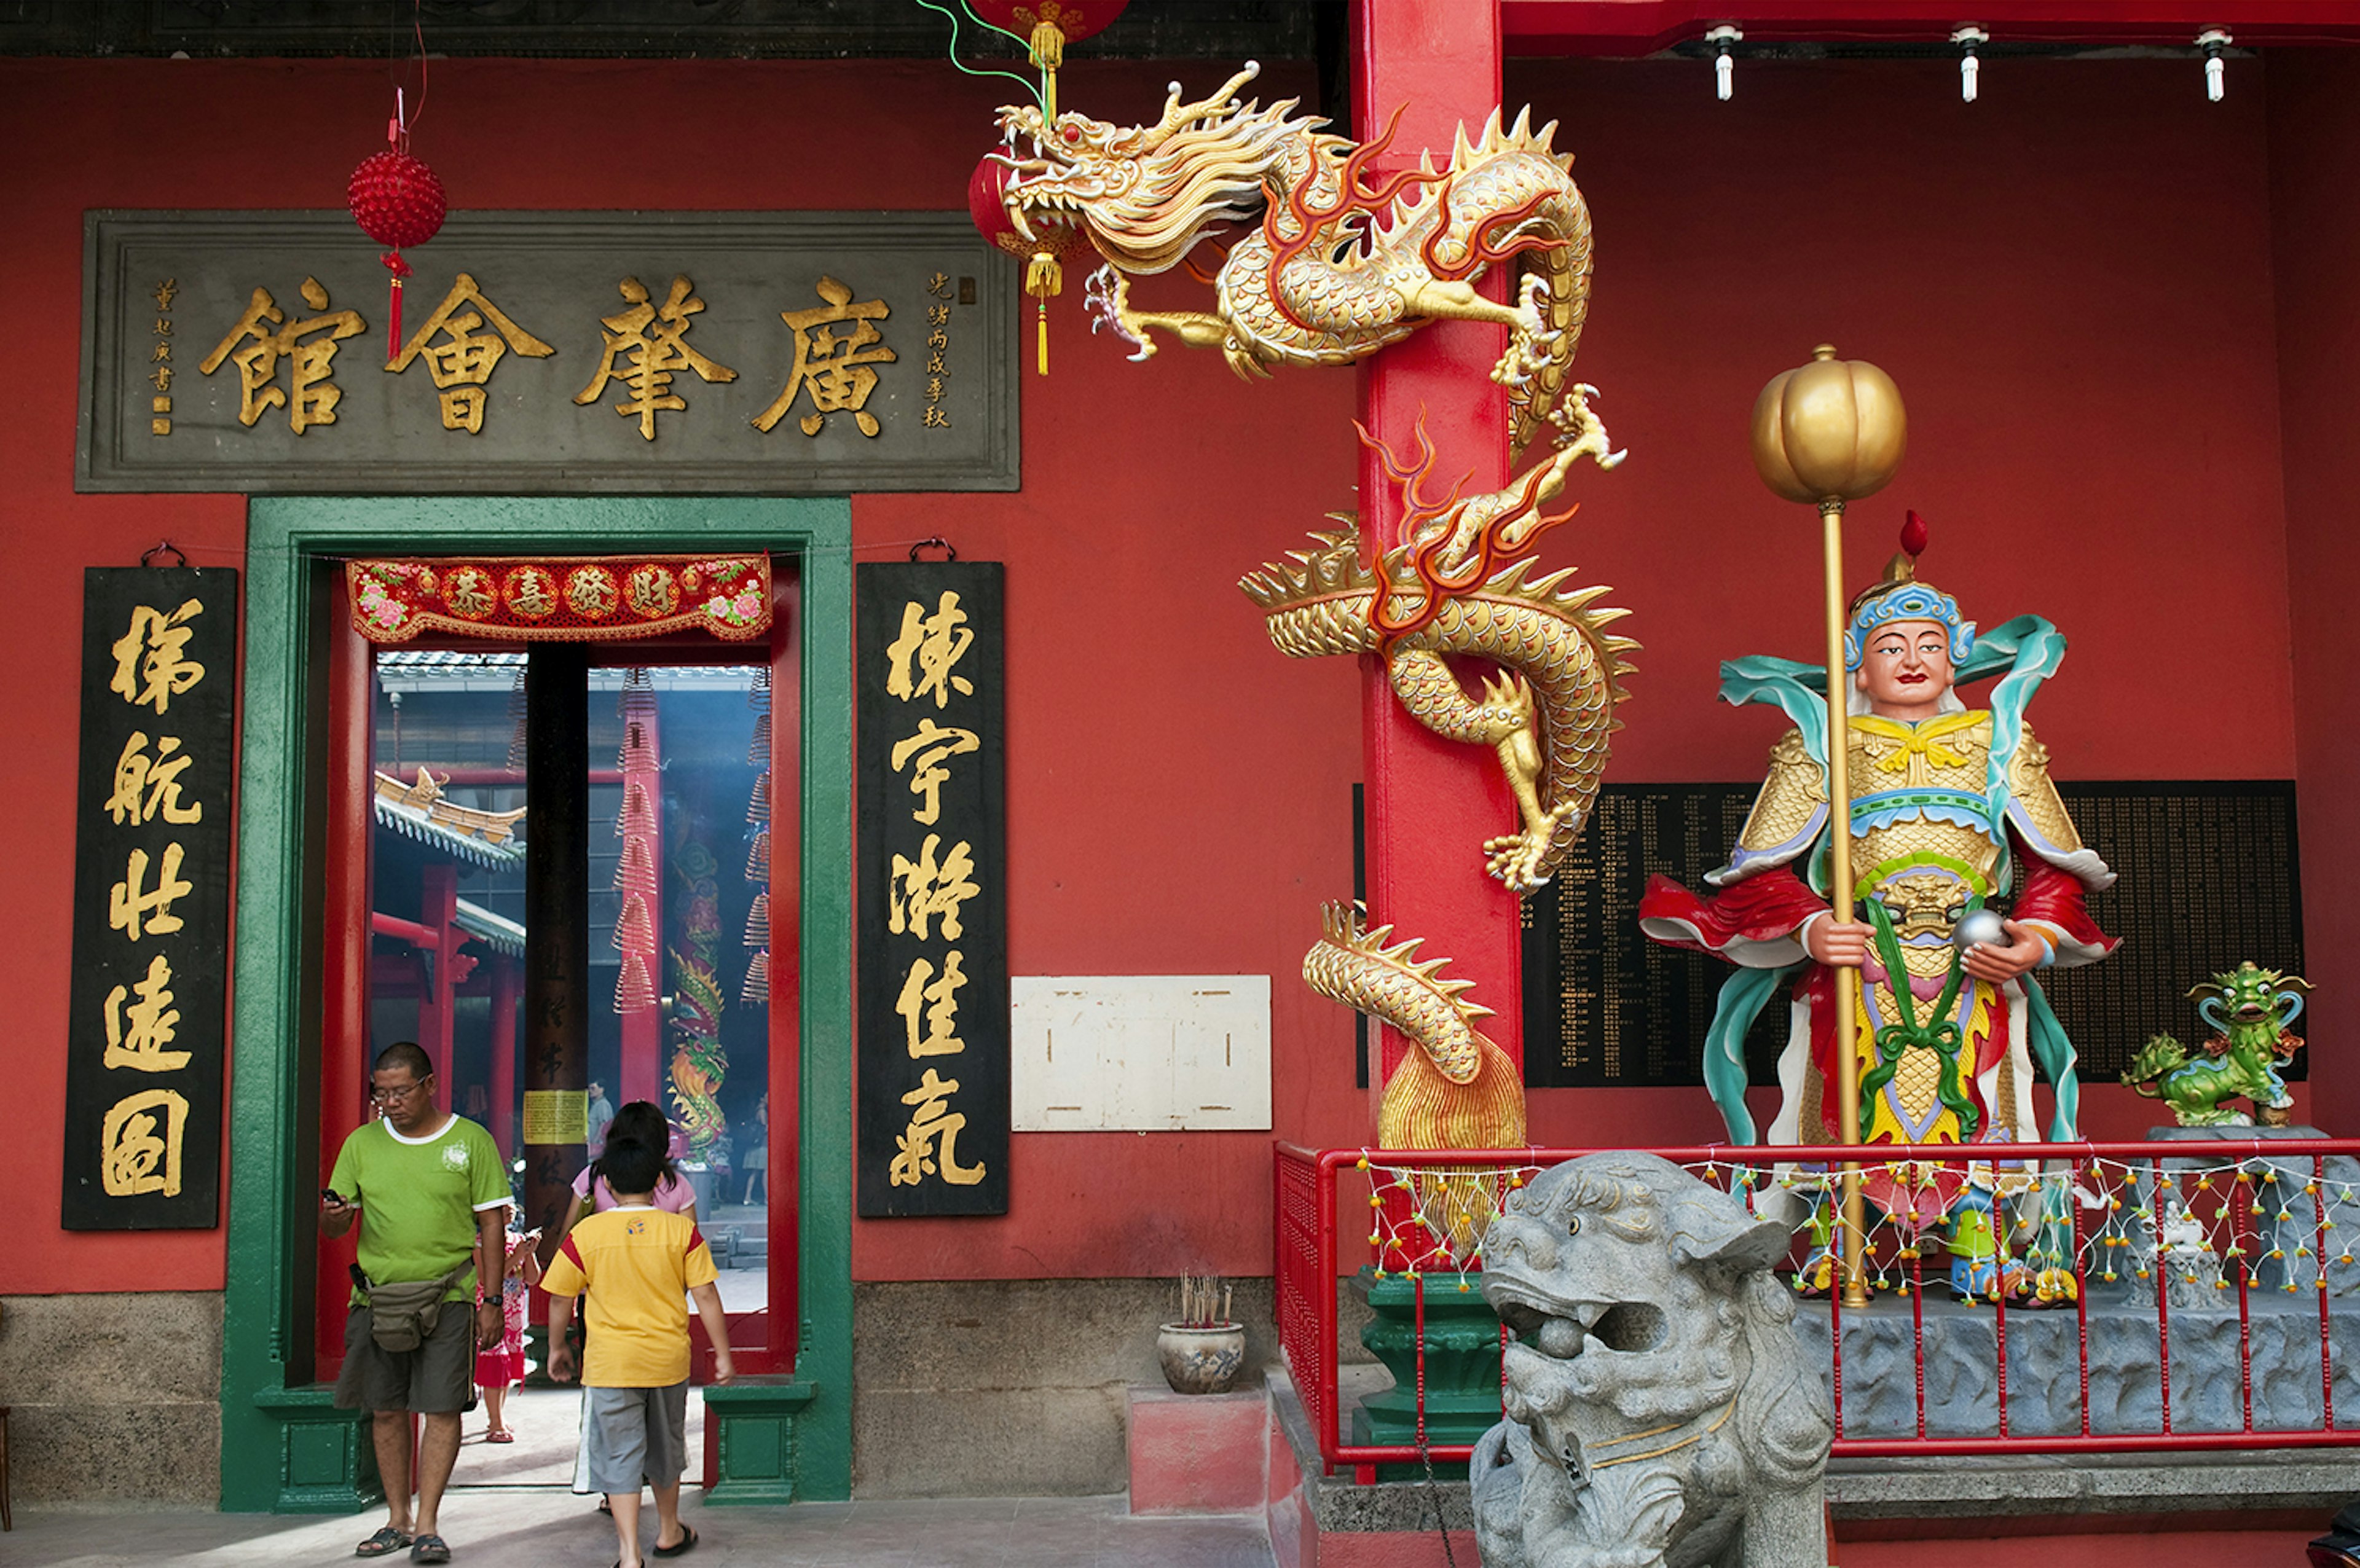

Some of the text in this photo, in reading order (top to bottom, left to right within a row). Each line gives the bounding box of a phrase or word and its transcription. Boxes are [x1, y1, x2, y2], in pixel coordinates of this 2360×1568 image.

[199, 273, 897, 440] 廣肇會館
[454, 570, 672, 613] 恭喜發財
